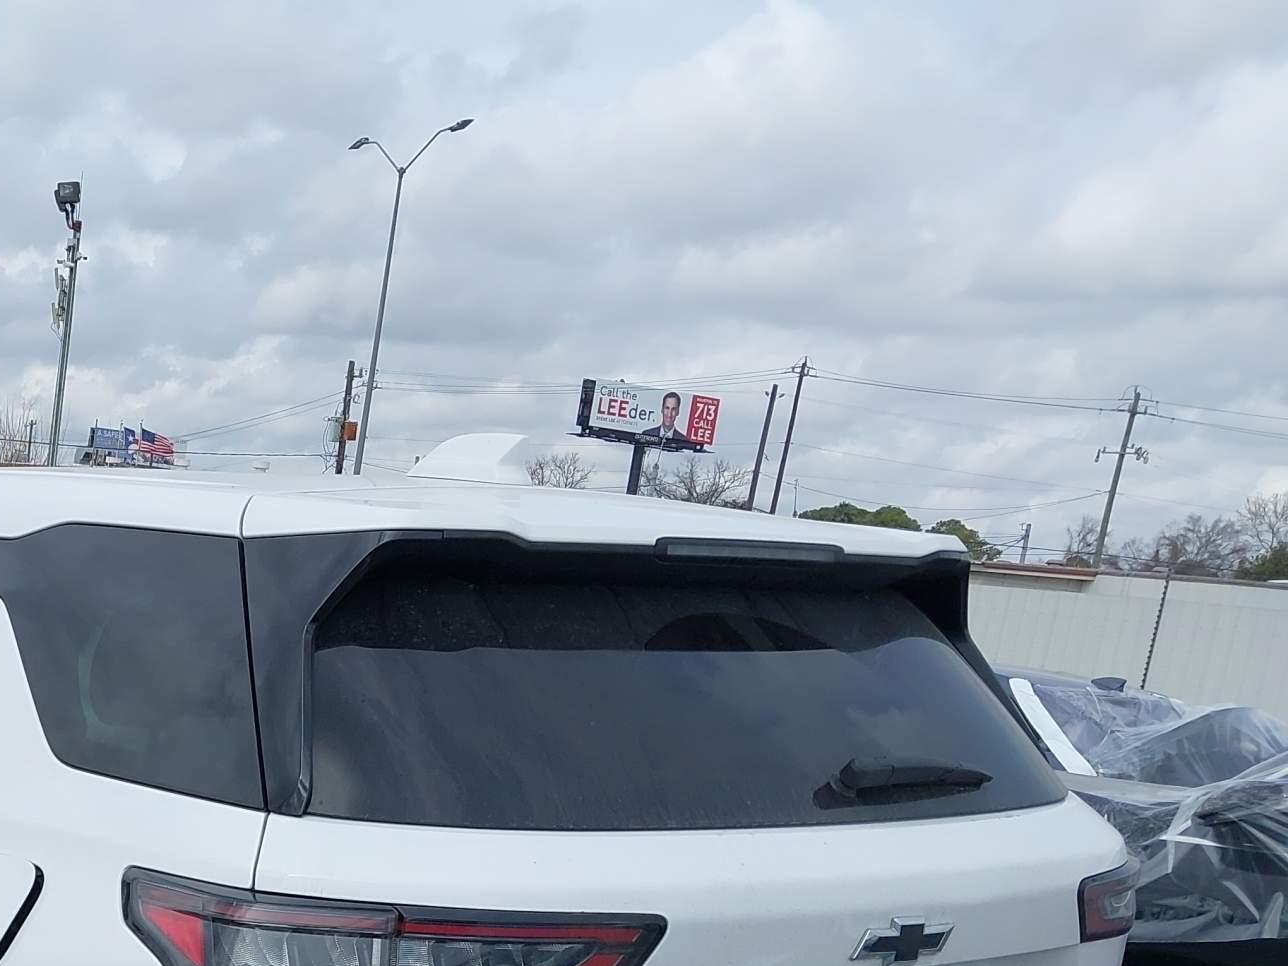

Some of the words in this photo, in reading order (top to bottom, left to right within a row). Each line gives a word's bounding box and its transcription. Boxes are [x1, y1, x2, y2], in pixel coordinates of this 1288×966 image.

[600, 385, 619, 398] Call
[622, 389, 638, 400] the
[694, 402, 716, 420] 713
[693, 418, 713, 429] CALL
[690, 427, 712, 442] LEE
